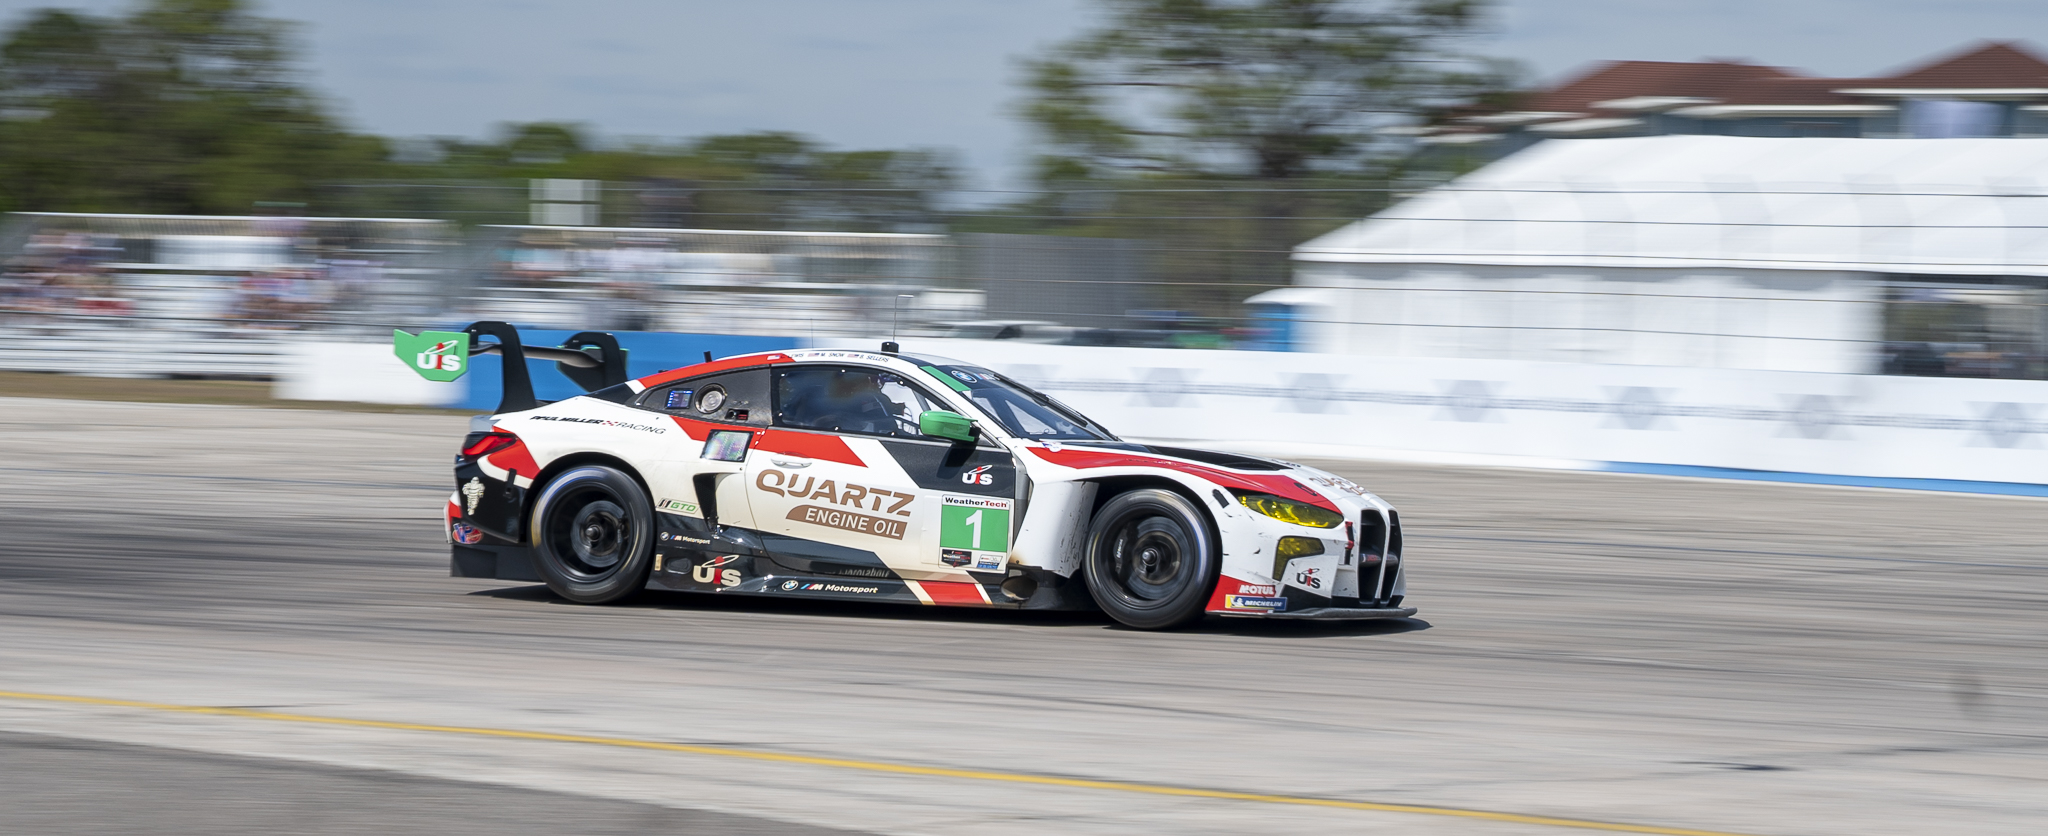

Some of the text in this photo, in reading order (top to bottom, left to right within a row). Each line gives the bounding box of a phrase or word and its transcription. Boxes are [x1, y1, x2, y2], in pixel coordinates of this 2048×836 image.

[866, 354, 890, 363] SELLERS
[558, 416, 604, 425] MILLER
[616, 421, 667, 435] RACING
[756, 469, 915, 517] QUARTZ
[670, 502, 697, 512] GTD
[945, 497, 1007, 508] WeatherTech
[805, 507, 901, 537] ENGINE OIL
[965, 509, 983, 549] 1
[682, 536, 711, 545] Motorsport
[824, 584, 879, 594] Motorsport
[1238, 584, 1275, 595] MOTUL
[1244, 599, 1283, 607] MICHELIN
